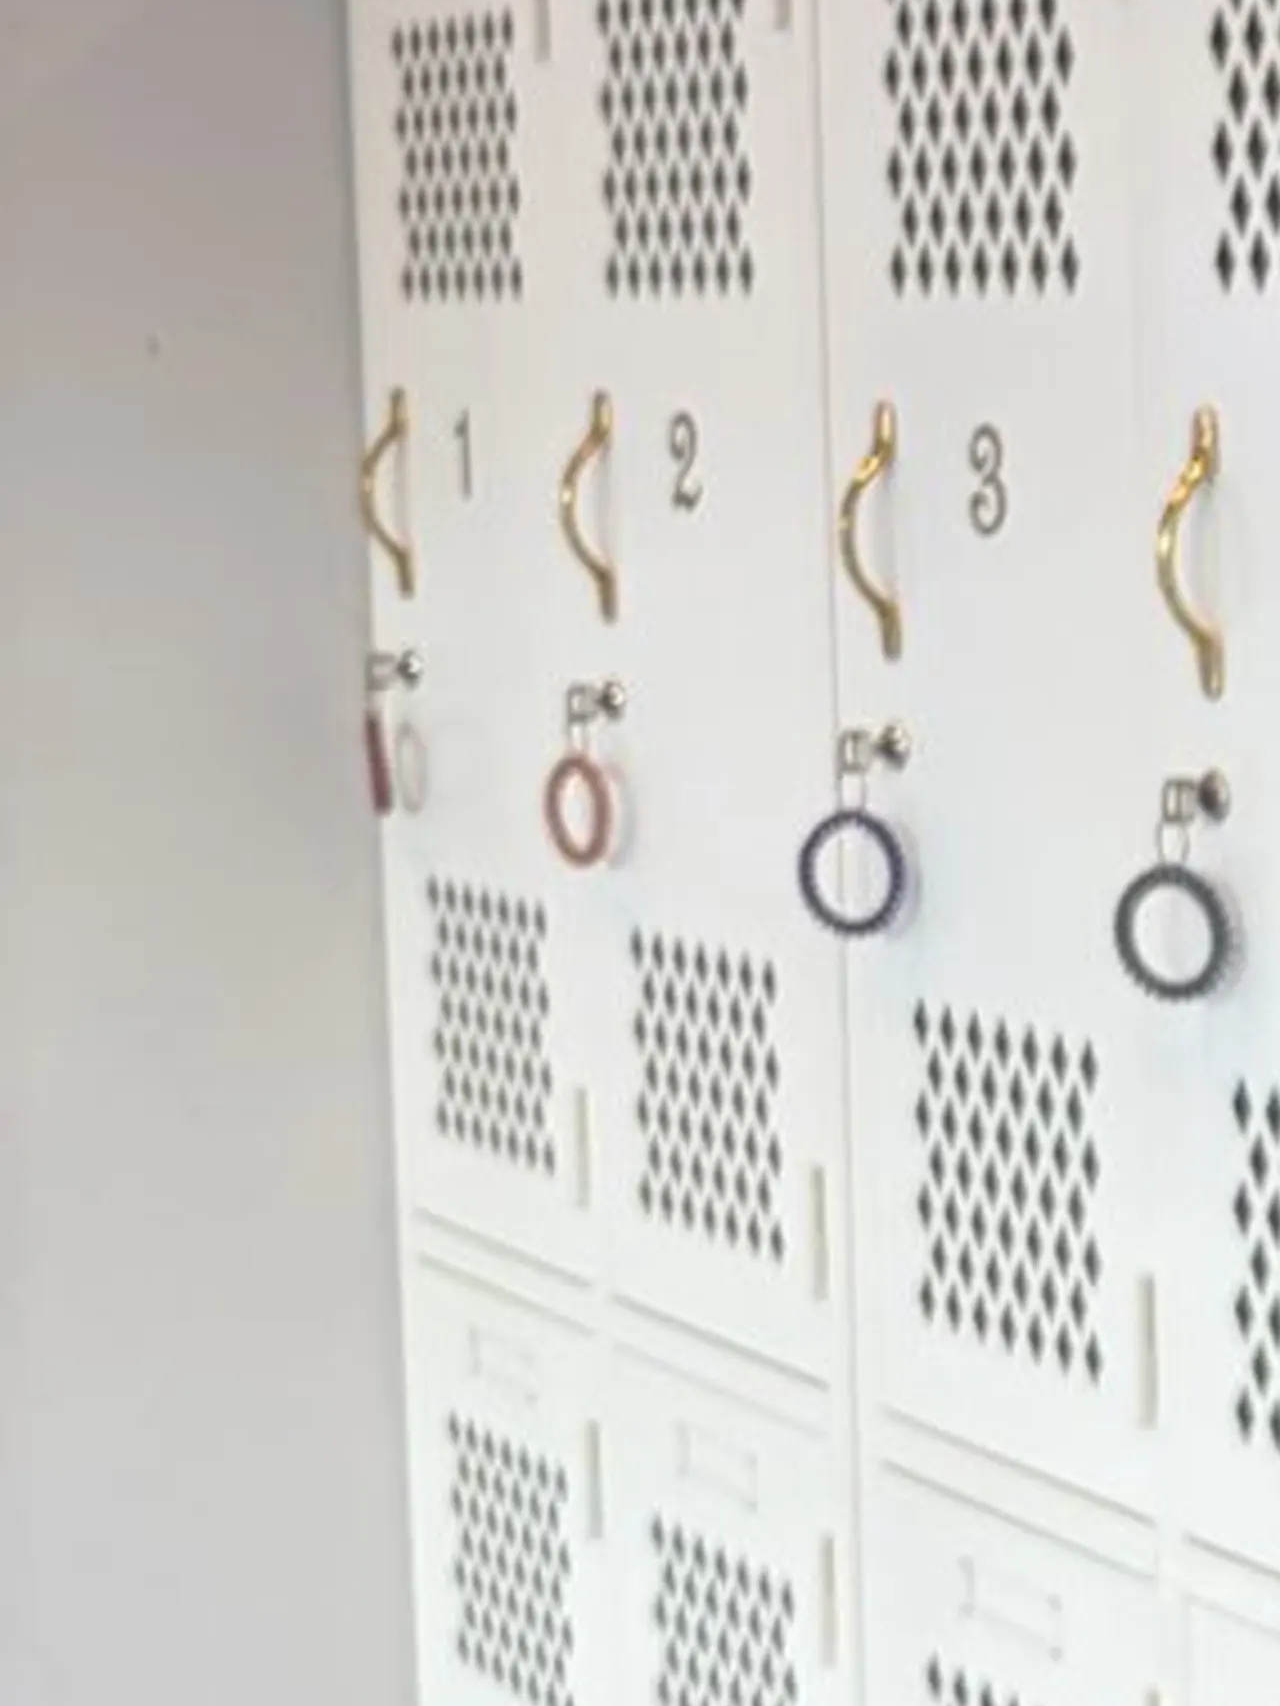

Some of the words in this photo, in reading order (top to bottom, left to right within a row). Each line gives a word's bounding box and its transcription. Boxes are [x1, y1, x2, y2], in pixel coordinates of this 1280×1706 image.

[450, 408, 474, 500] 1
[667, 410, 702, 512] 2
[967, 423, 1008, 537] 3
